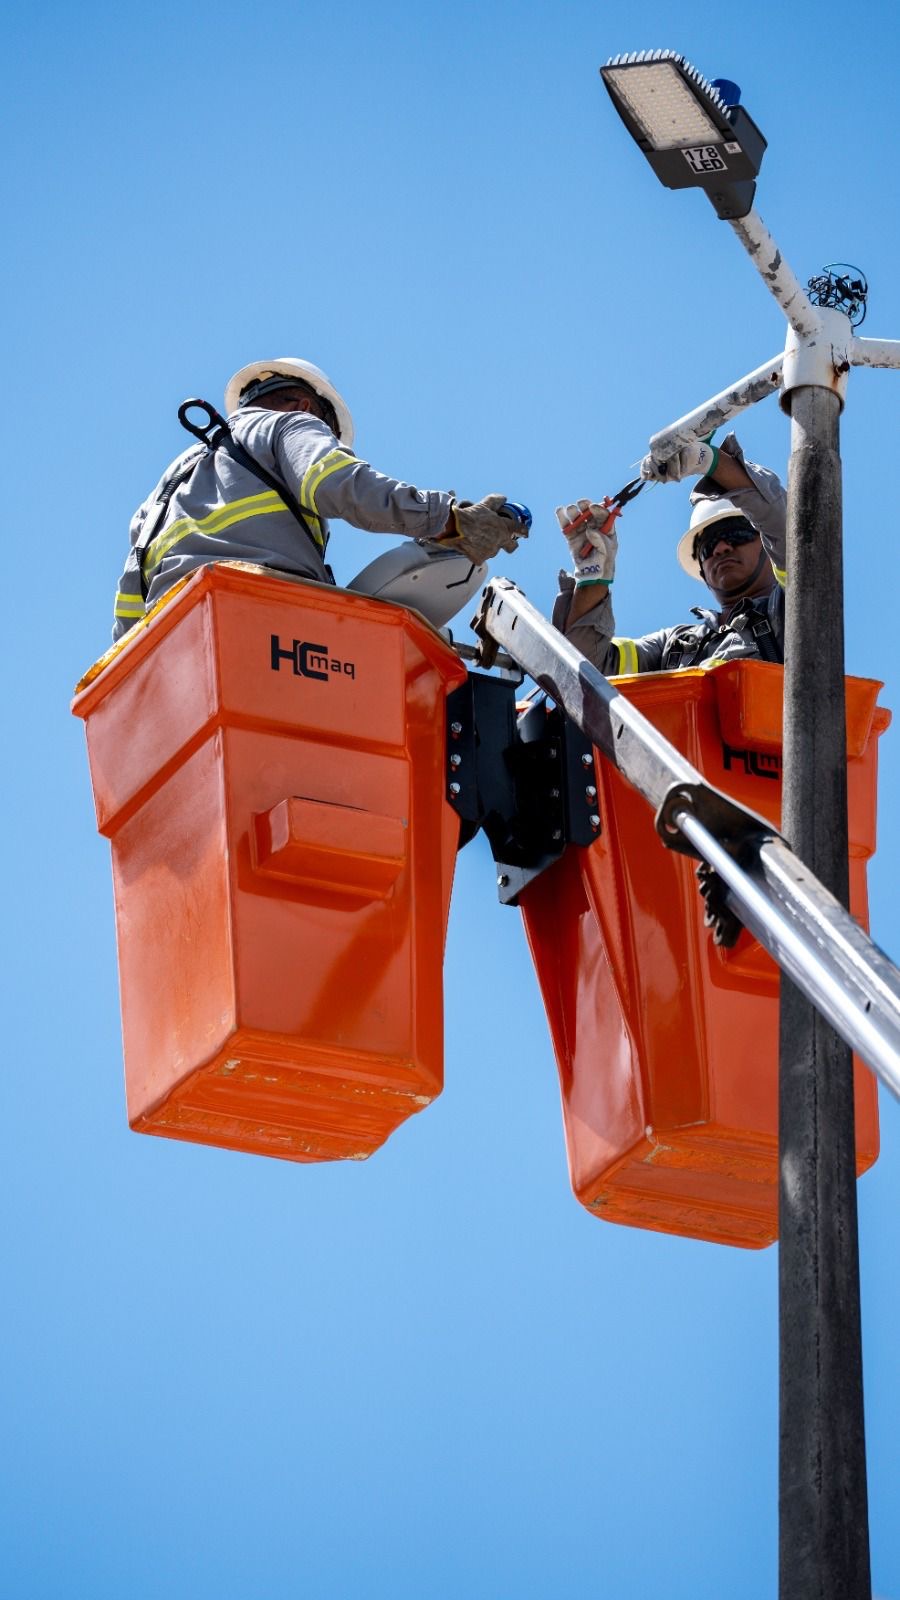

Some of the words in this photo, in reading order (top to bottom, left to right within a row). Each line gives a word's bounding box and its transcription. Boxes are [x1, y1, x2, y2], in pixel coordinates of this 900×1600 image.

[685, 147, 718, 161] 178
[690, 158, 725, 172] LED
[271, 634, 355, 681] HCmaq
